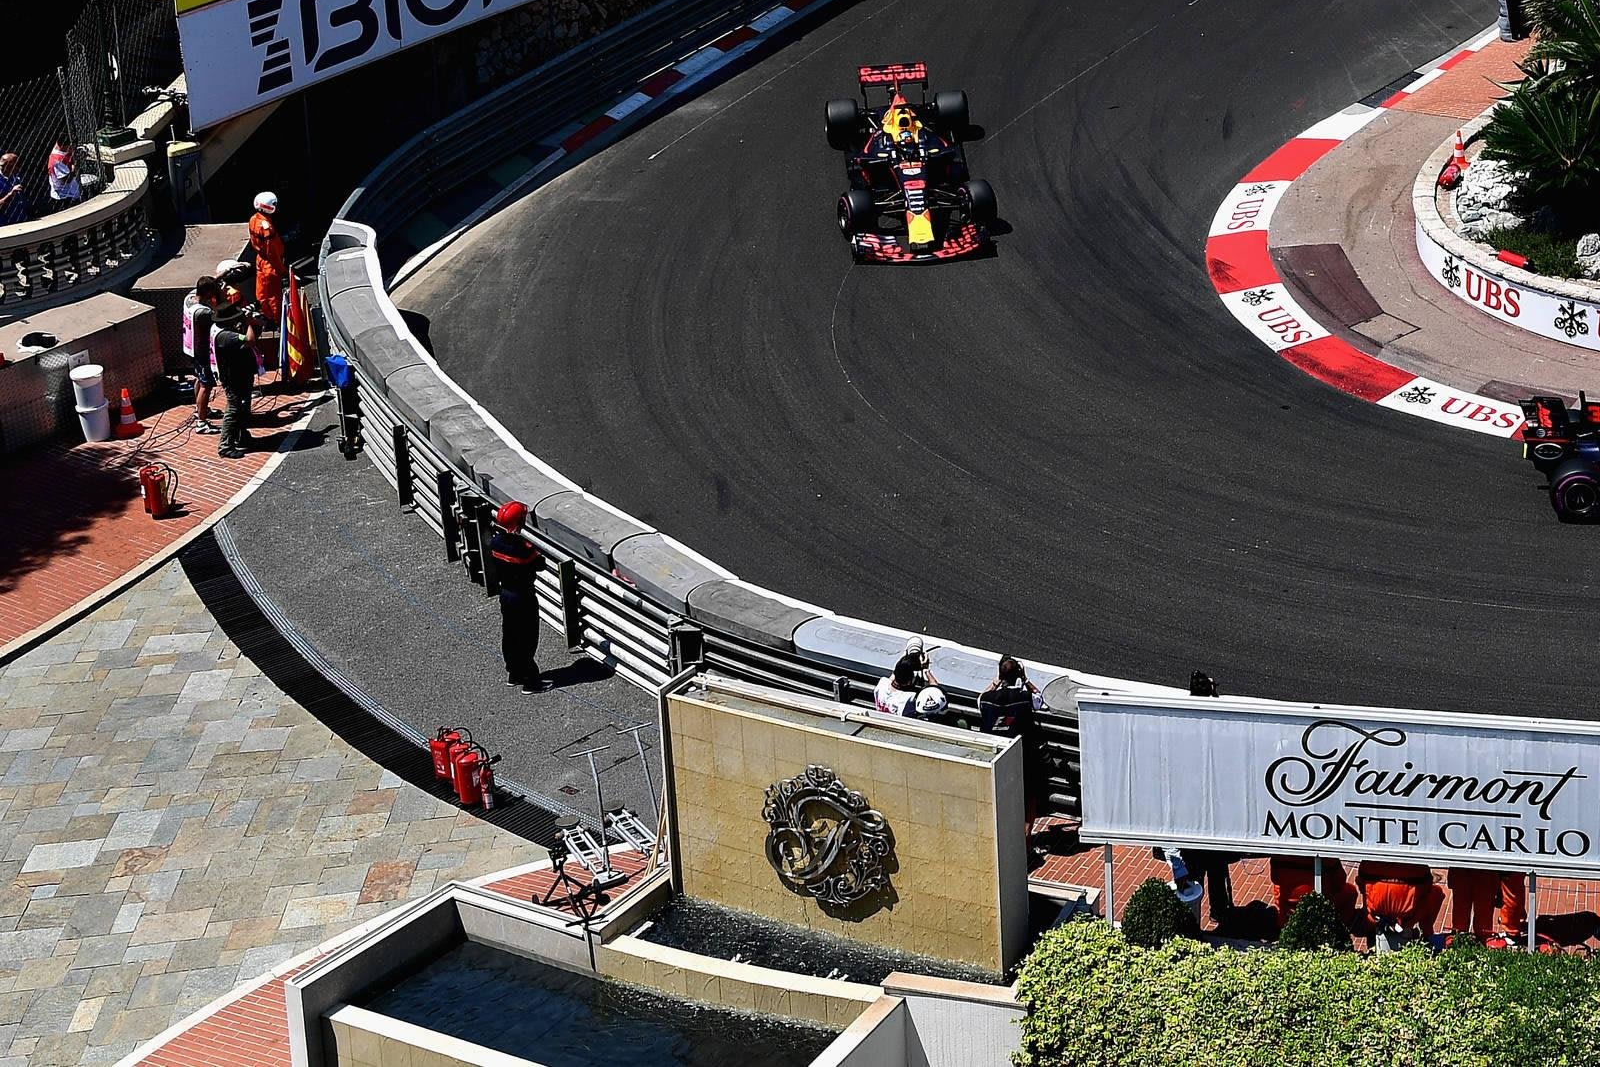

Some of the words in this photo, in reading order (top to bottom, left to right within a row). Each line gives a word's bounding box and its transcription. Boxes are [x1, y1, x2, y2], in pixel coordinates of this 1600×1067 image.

[1227, 198, 1265, 232] UBS
[1464, 267, 1521, 319] UBS
[1257, 304, 1314, 344] UBS
[1440, 396, 1522, 430] UBS
[1264, 719, 1588, 821] Fairmont
[1261, 809, 1420, 847] MONTE
[1438, 821, 1592, 858] CARLO
